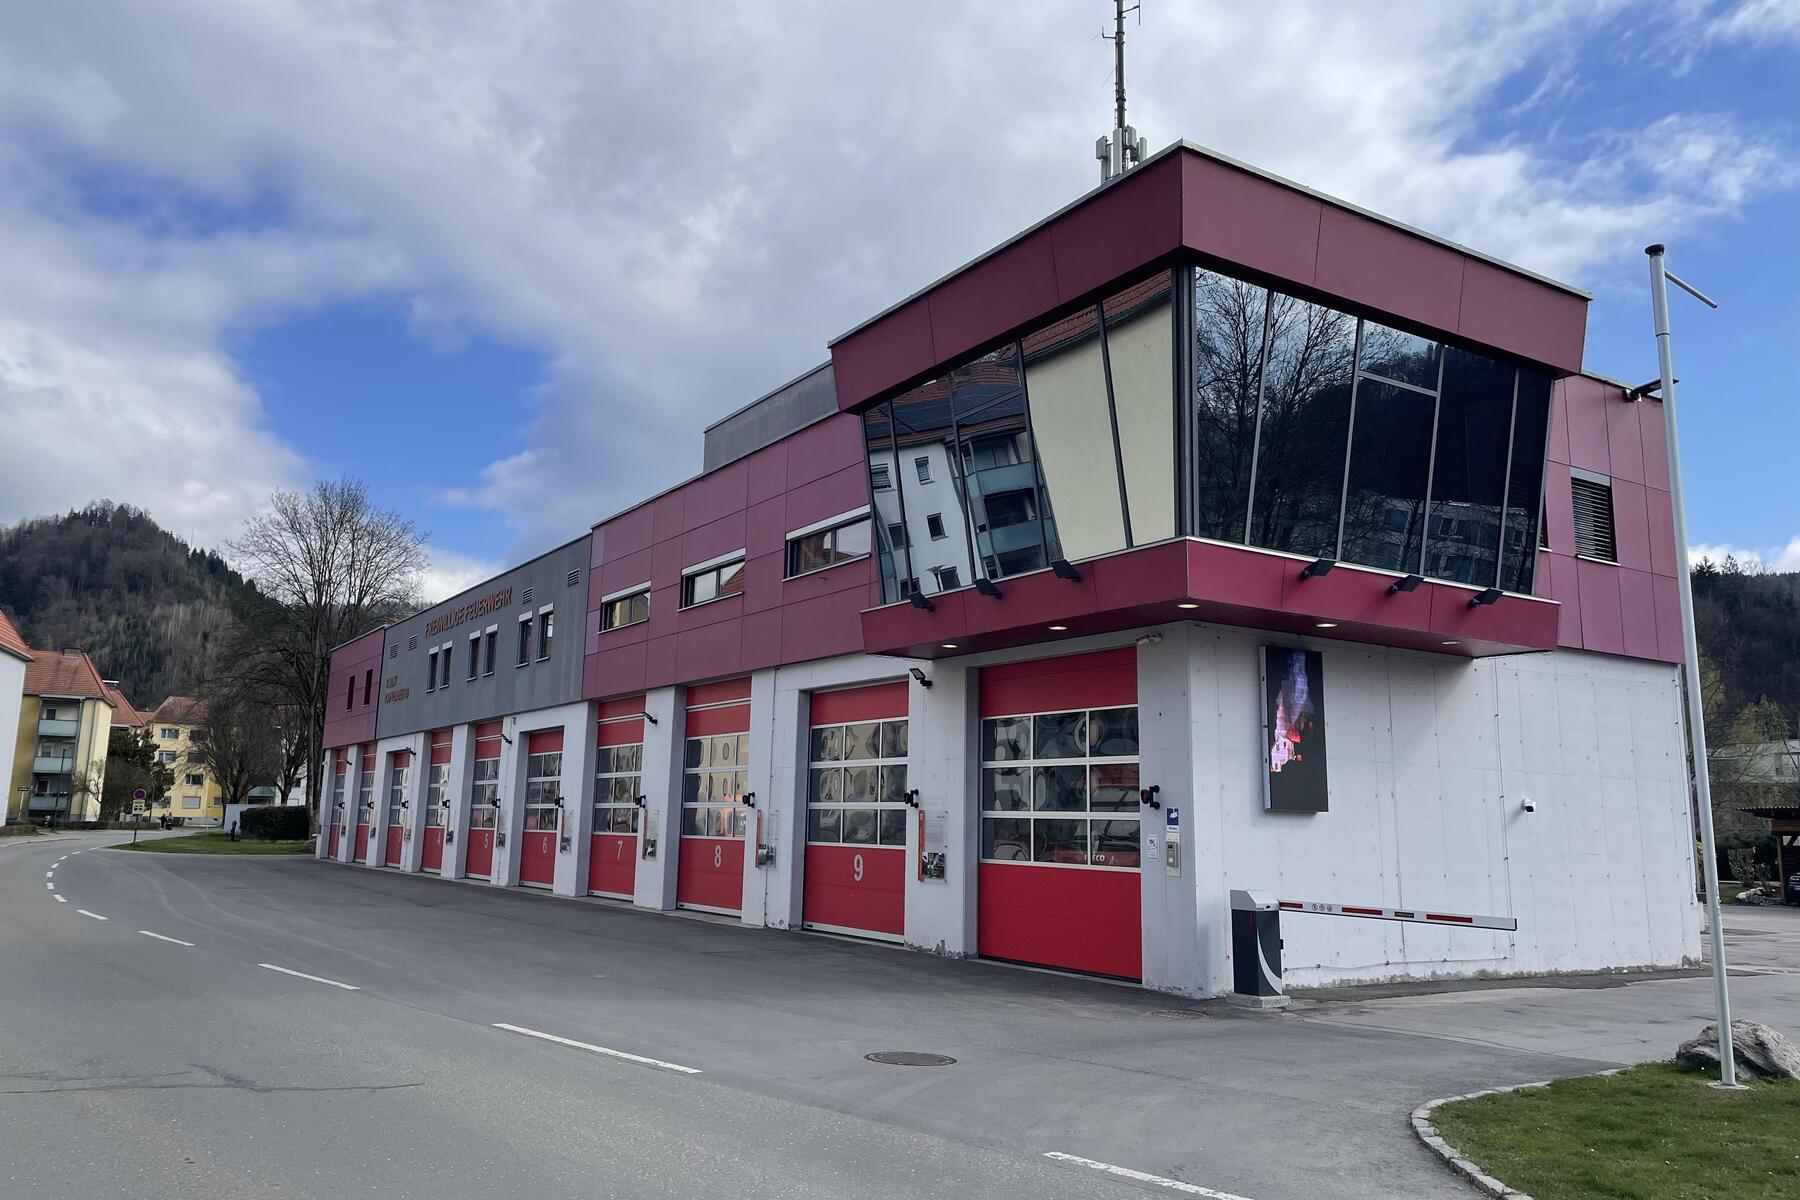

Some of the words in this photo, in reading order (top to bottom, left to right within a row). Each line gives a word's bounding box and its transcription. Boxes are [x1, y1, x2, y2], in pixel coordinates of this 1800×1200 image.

[464, 585, 512, 622] FEUERWEHR
[483, 833, 489, 849] 5
[542, 836, 548, 854] 6
[617, 840, 623, 861] 7
[714, 844, 722, 868] 8
[1084, 854, 1106, 862] IECO
[853, 854, 864, 881] 9
